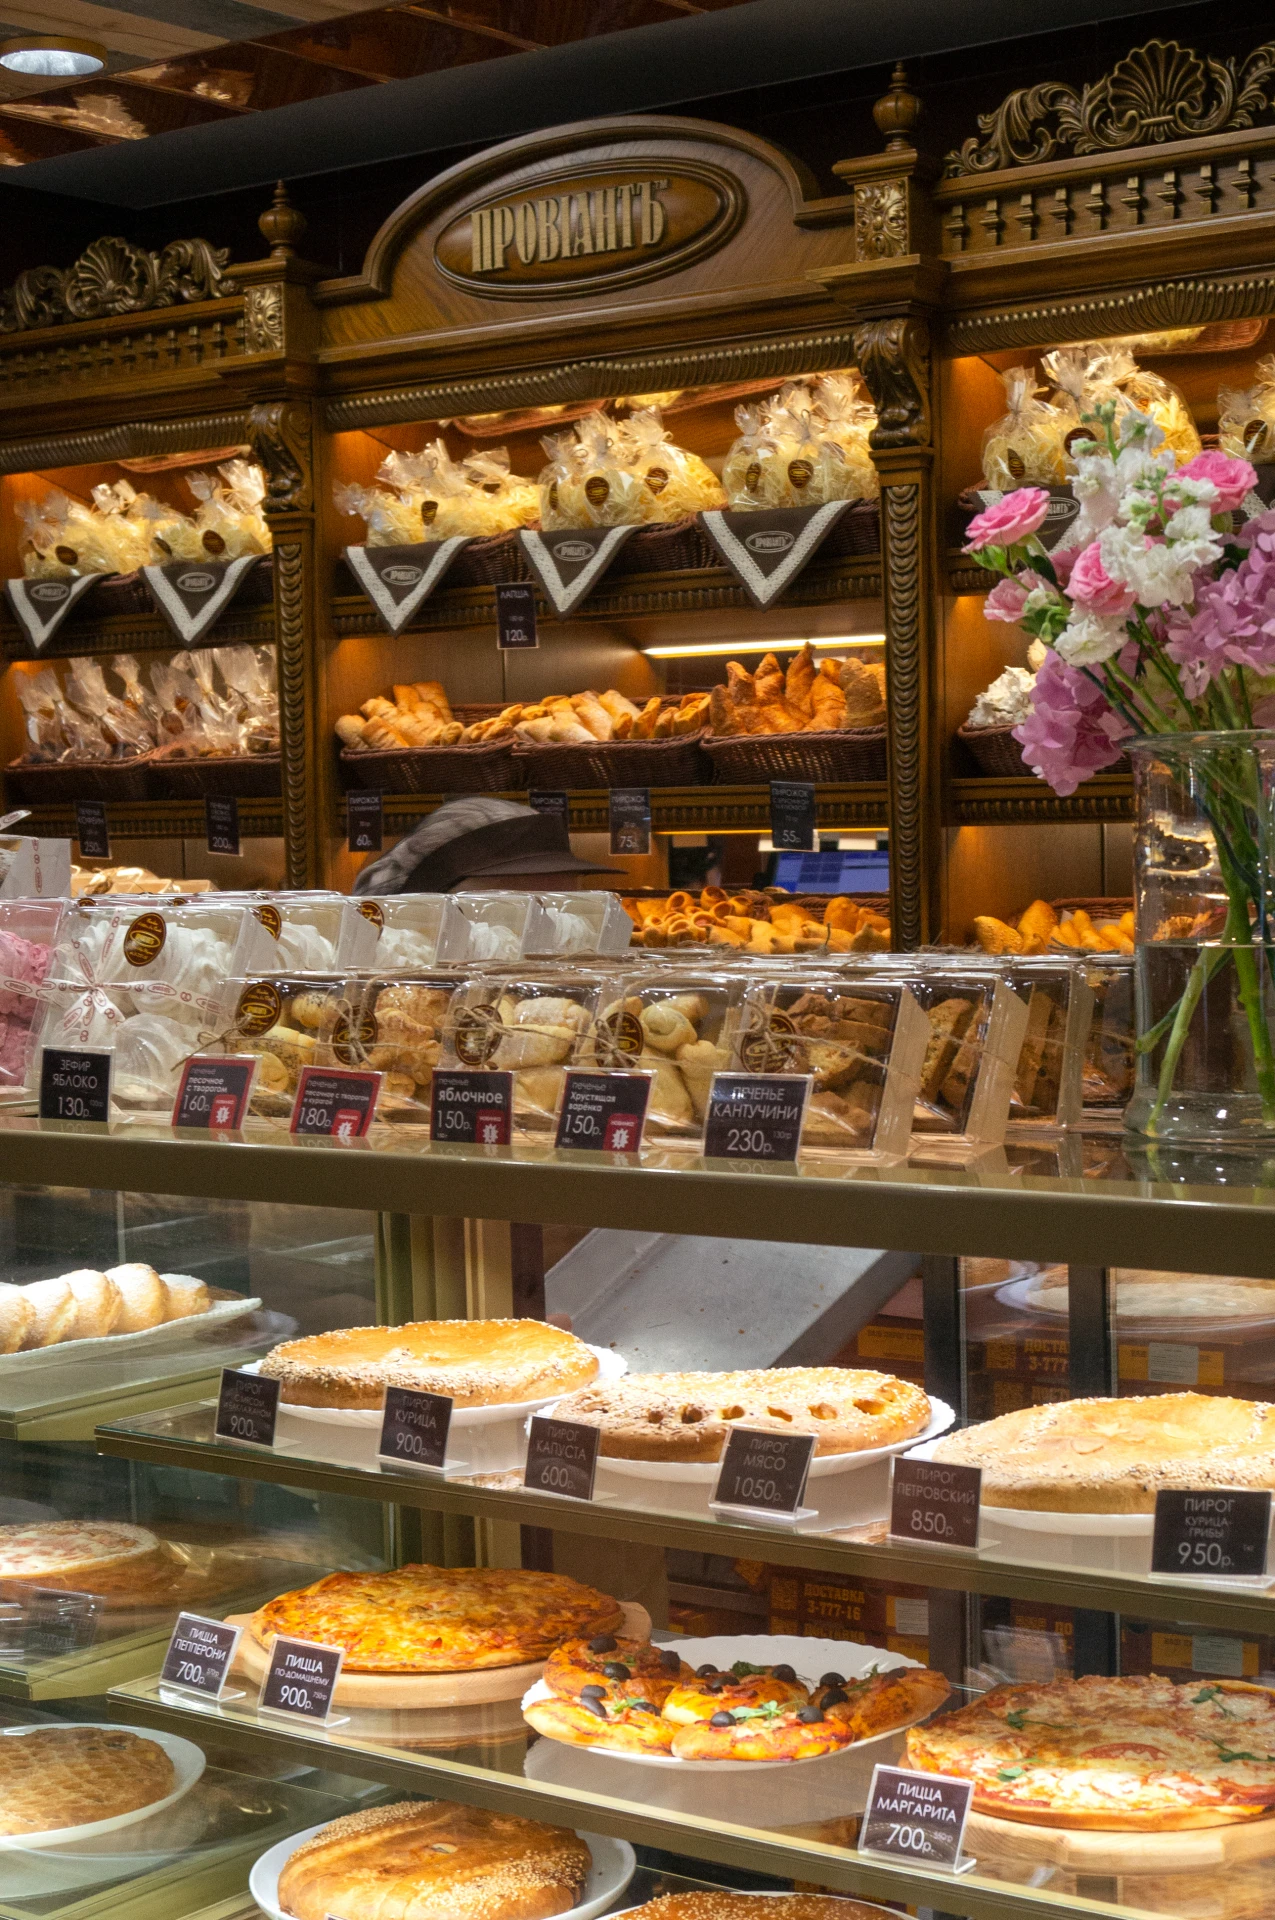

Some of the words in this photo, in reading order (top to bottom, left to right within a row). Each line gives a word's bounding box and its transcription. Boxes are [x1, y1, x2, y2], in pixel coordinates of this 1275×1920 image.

[471, 181, 665, 273] ПРОВІАНТЪ
[500, 590, 529, 599] ЛАПША
[60, 1060, 91, 1072] ЗЕФИР
[52, 1073, 98, 1089] ЯБЛОКО
[187, 1077, 225, 1085] песочное
[193, 1085, 228, 1094] творогом
[438, 1087, 504, 1104] яблочное
[570, 1091, 617, 1103] Хрустящая
[731, 1086, 786, 1101] ПЕЧЕНЬЕ
[59, 1096, 94, 1118] 130р.
[568, 1102, 603, 1112] варёнка
[713, 1103, 798, 1120] КАНТУЧИНИ
[437, 1110, 473, 1131] 150р.
[565, 1114, 602, 1136] 150р.
[727, 1129, 775, 1155] 230р.
[402, 1395, 434, 1411] ПИРОГ
[395, 1409, 437, 1429] КУРИЦА
[547, 1426, 580, 1442] ПИРОГ
[536, 1440, 586, 1461] КАПУСТА
[749, 1438, 789, 1454] ПИРОГ
[743, 1454, 786, 1471] МЯСО
[541, 1465, 576, 1491] 600р.
[916, 1467, 956, 1484] ПИРОГ
[734, 1476, 783, 1502] 1050р.
[896, 1482, 975, 1505] ПЕТРОВСКИЙ
[1184, 1498, 1236, 1513] ПИРОГ
[911, 1509, 957, 1537] 850р.
[1189, 1527, 1224, 1539] ГРИБЫ
[1178, 1541, 1235, 1568] 950р.
[804, 1583, 865, 1604] ДОСТАВКА
[807, 1600, 861, 1621] 3-777-16
[189, 1627, 219, 1645] ПИЦЦА
[174, 1638, 227, 1662] ПЕППЕРОНИ
[176, 1661, 207, 1685] 700р.
[285, 1654, 323, 1674] ПИЦЦА
[274, 1667, 330, 1686] ПО-ДОМАШНЕМУ
[280, 1685, 314, 1710] 900р.
[897, 1782, 943, 1802] ПИЦЦА
[876, 1796, 957, 1823] МАРГАРИТА
[886, 1823, 934, 1853] 700р.
